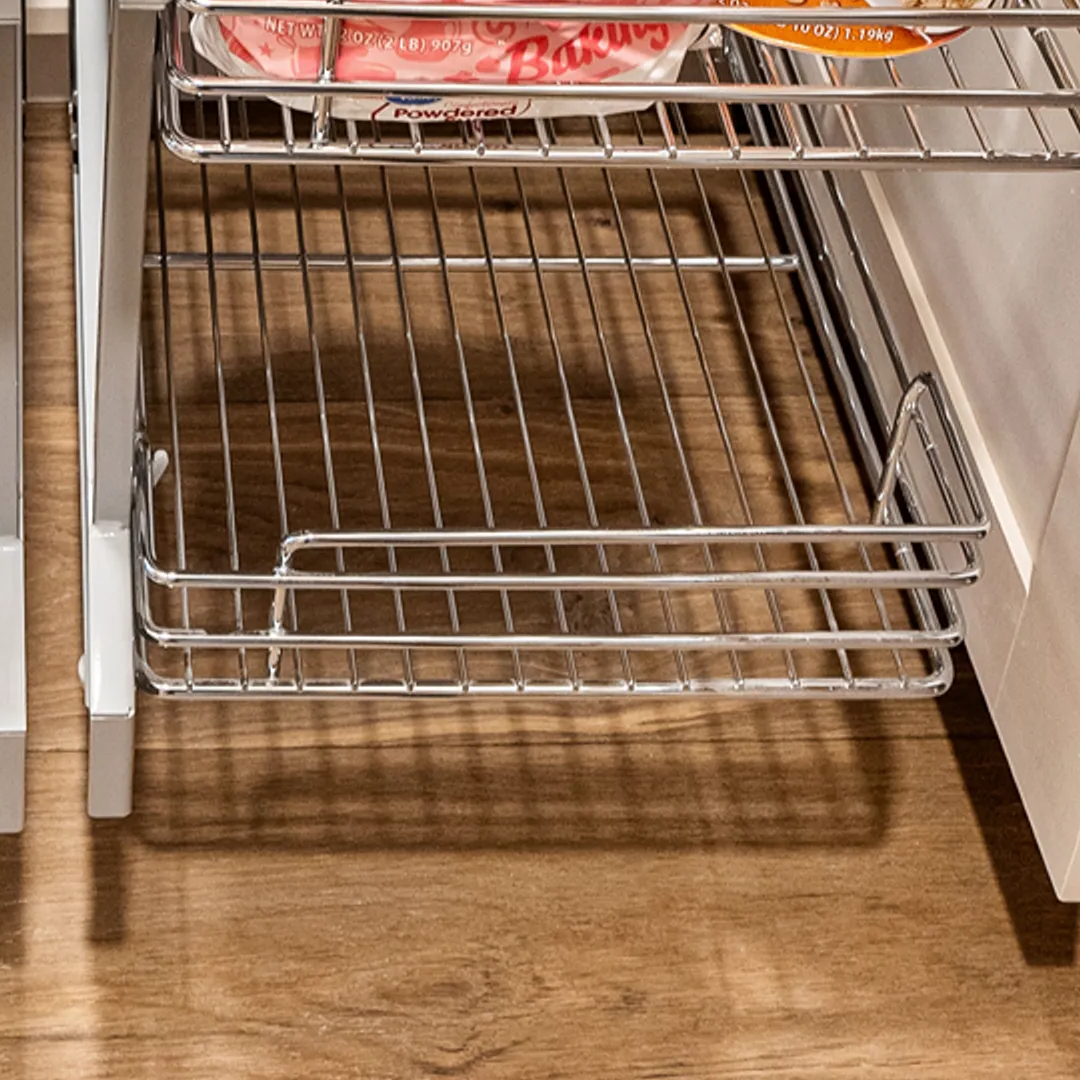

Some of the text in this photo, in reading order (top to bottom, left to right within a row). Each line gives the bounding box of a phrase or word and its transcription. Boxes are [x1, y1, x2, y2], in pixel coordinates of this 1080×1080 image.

[264, 18, 297, 36] NET
[399, 37, 427, 53] LB)
[431, 39, 473, 54] 907g
[844, 27, 895, 44] 1.19kg
[394, 106, 517, 119] Powdered
